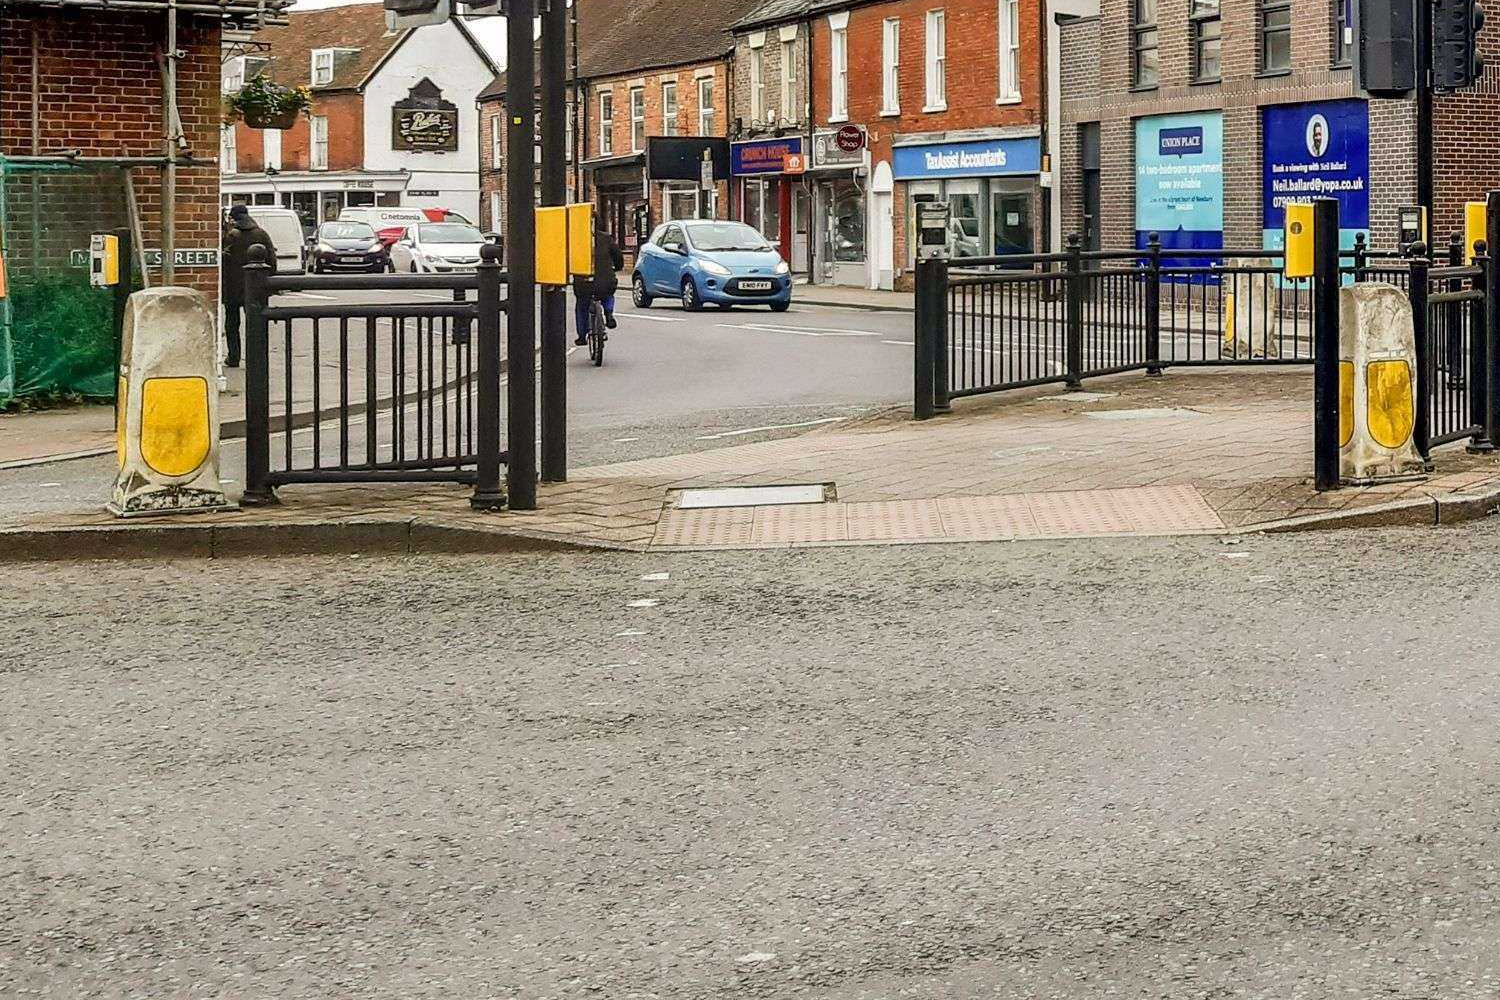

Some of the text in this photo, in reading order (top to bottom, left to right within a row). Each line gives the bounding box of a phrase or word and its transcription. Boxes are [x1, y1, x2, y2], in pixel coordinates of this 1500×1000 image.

[1161, 136, 1200, 148] UNION PLACE
[925, 148, 1007, 170] TaxAssist Accountants
[1289, 163, 1308, 174] viewing
[1308, 162, 1320, 171] with
[1272, 176, 1364, 193] Neil.ballard@yopa.co.uk
[154, 252, 215, 264] SREET
